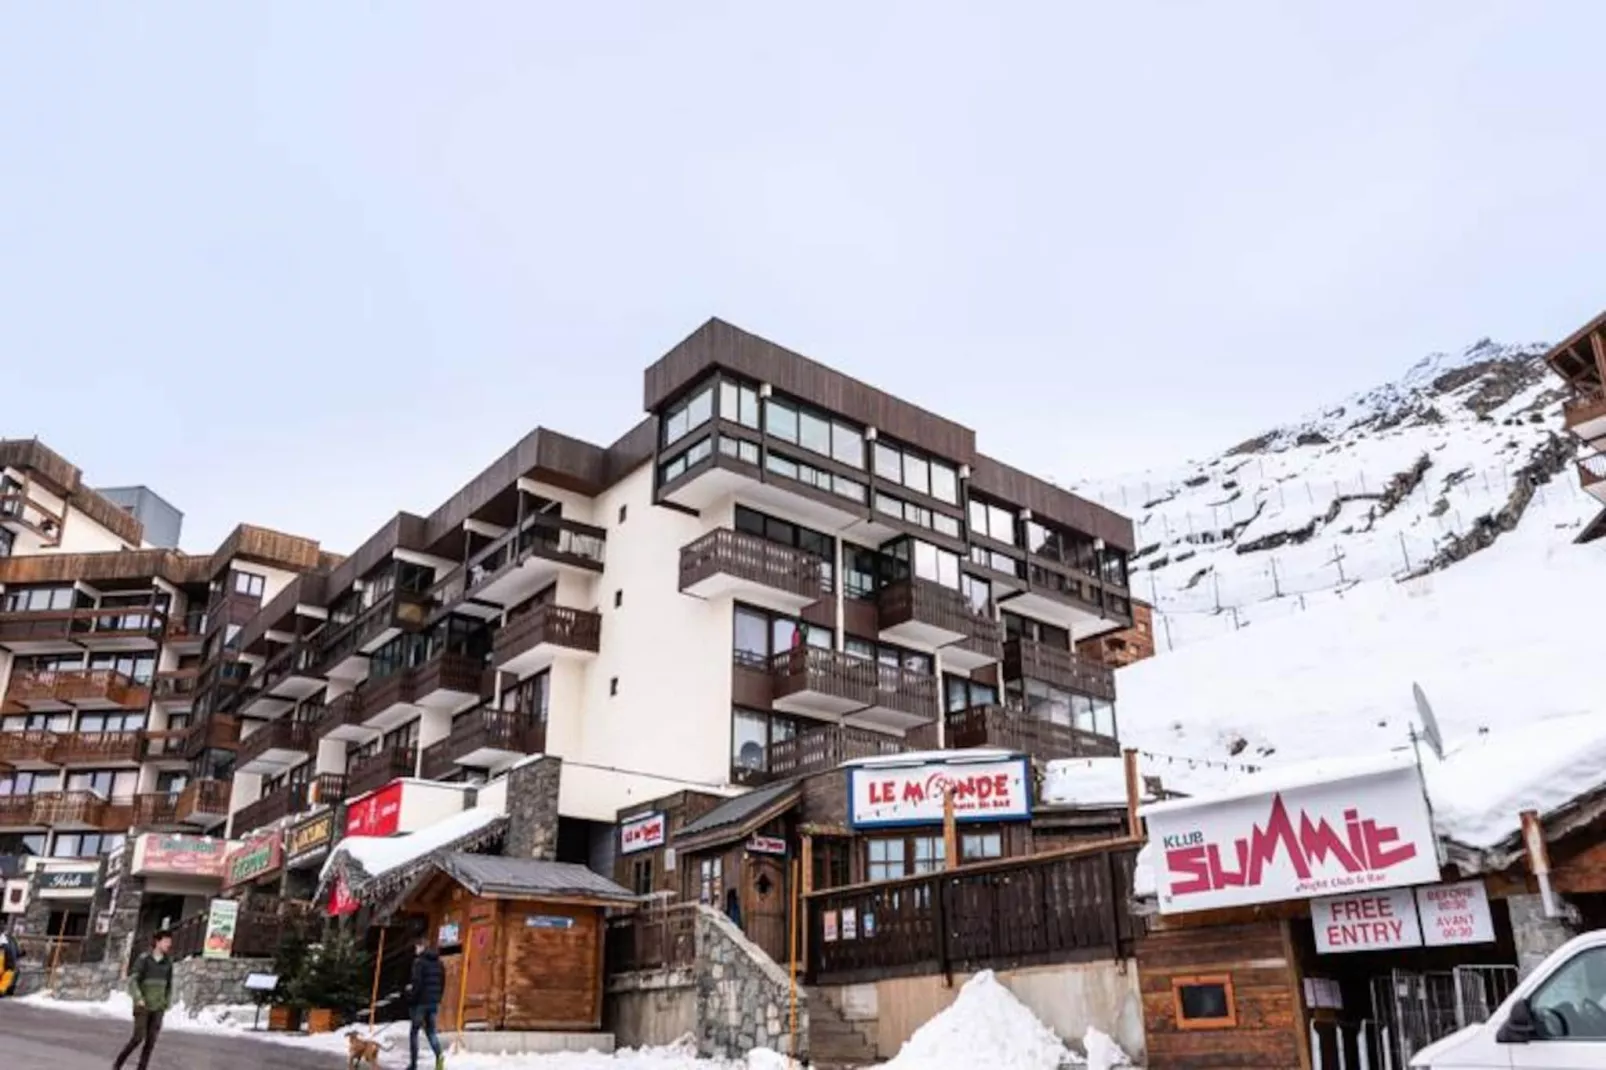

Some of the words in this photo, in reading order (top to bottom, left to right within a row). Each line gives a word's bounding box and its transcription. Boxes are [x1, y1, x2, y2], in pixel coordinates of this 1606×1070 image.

[868, 781, 896, 805] LE
[902, 771, 1010, 802] MONDE
[1163, 831, 1204, 849] KLUB
[1330, 896, 1394, 922] FREE
[1436, 914, 1474, 927] AVANT
[1326, 920, 1403, 947] ENTRY
